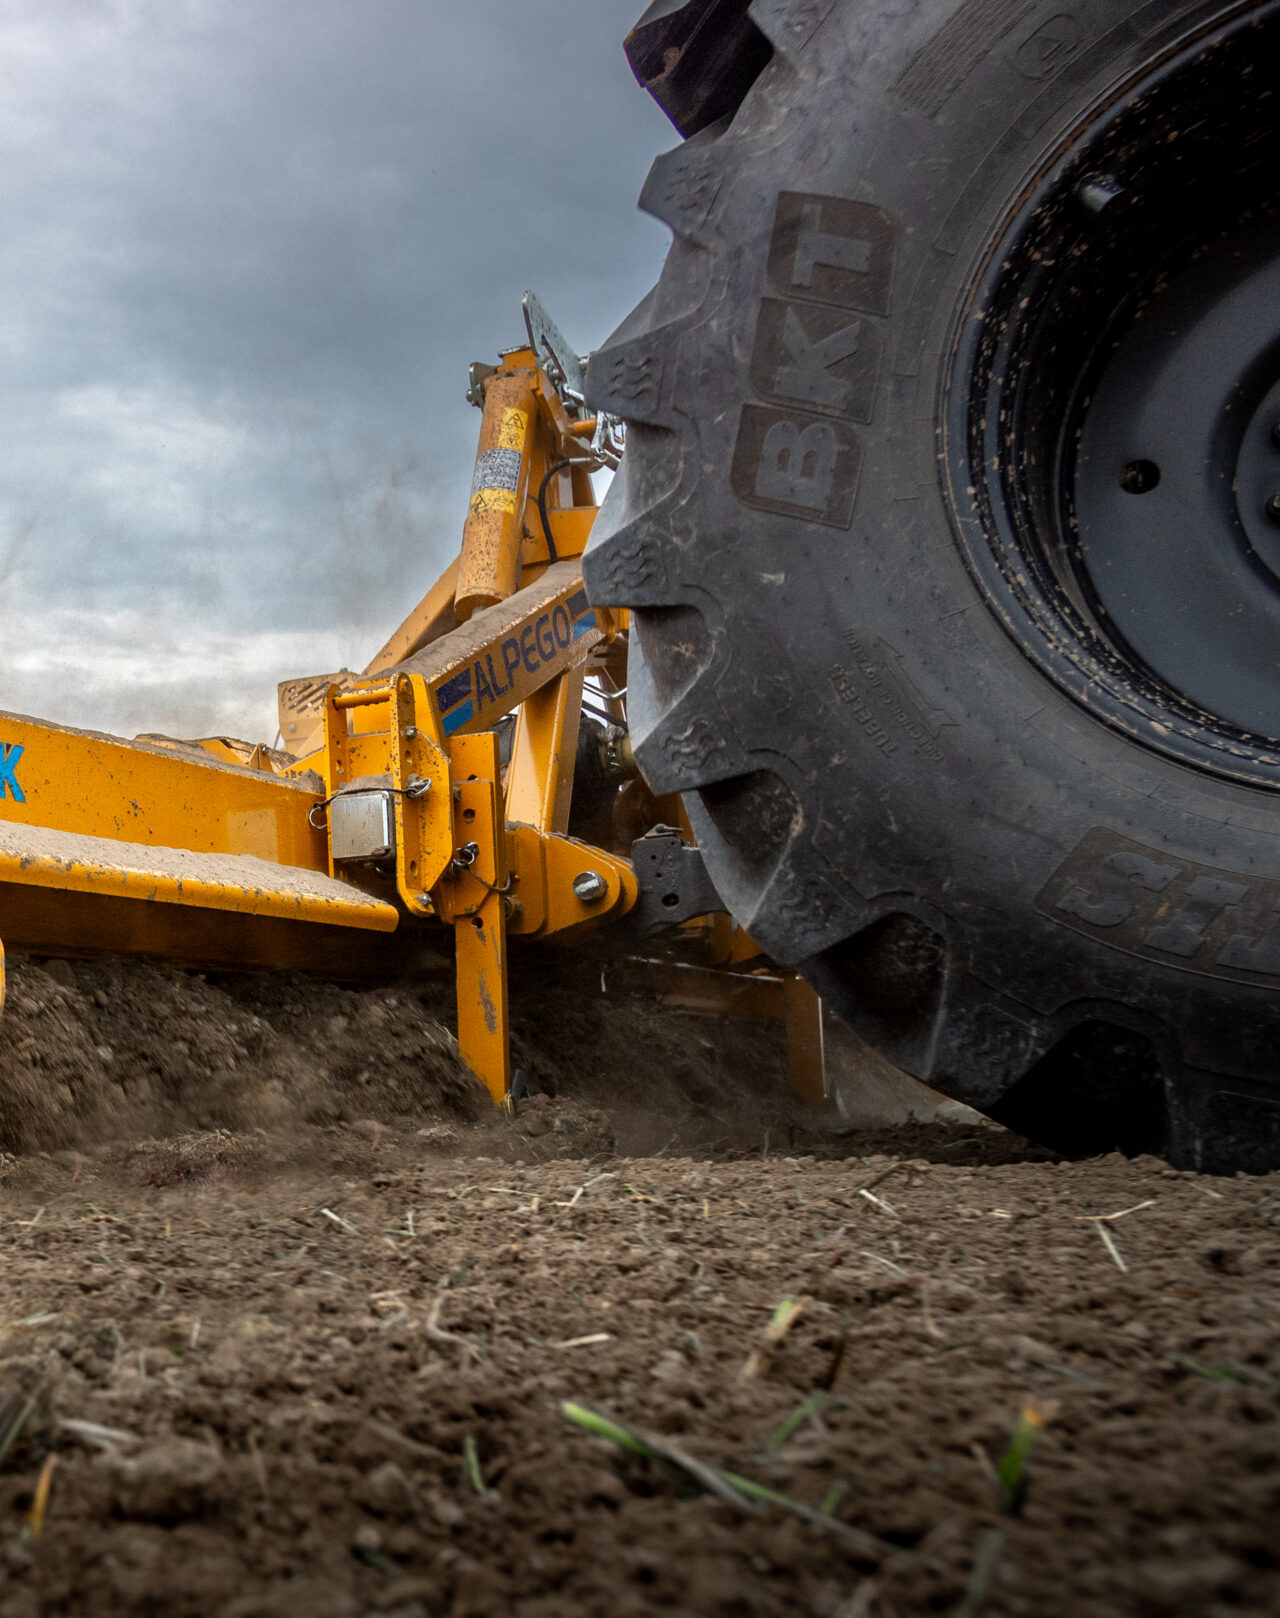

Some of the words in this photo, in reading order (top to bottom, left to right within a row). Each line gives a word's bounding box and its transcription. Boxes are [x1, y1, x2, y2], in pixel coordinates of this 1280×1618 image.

[754, 203, 873, 512] BKT
[470, 604, 573, 712] ALPEGO
[829, 663, 899, 759] TUBELESS
